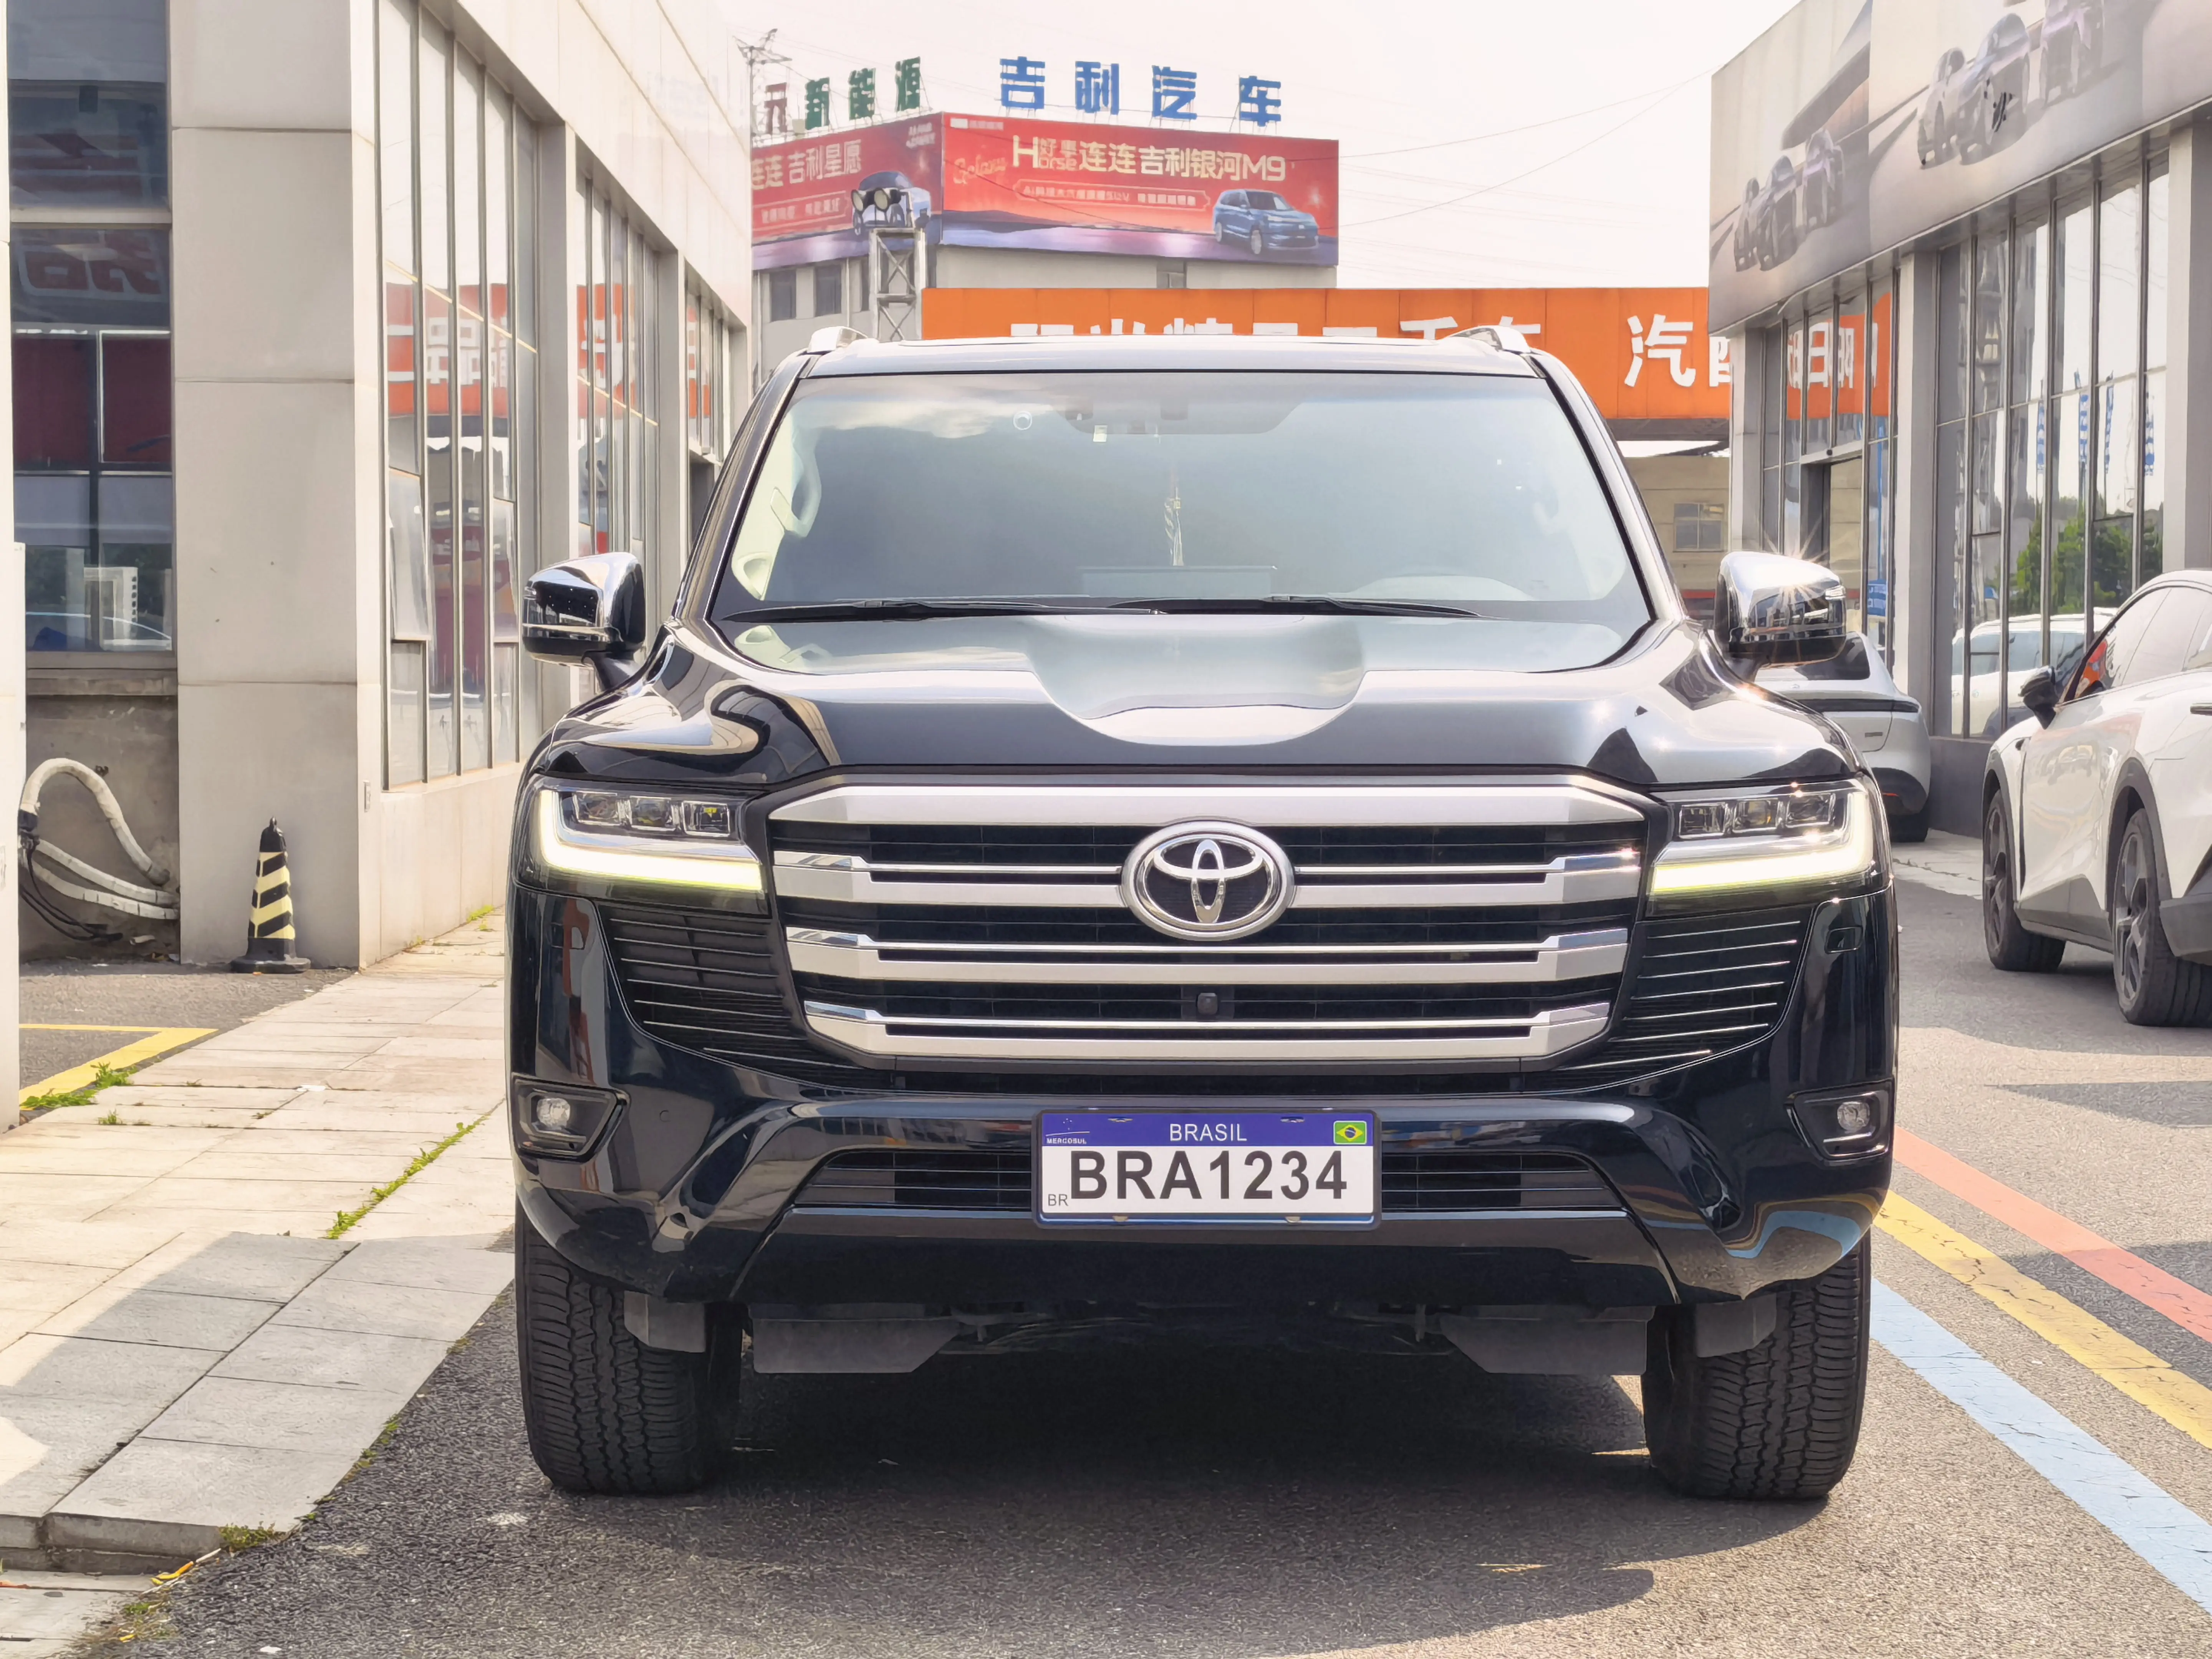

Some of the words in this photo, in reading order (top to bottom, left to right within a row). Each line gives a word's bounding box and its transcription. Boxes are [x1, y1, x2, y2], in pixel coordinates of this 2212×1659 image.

[1000, 56, 1281, 127] 吉利汽车
[1169, 1123, 1247, 1142] BRASIL
[1070, 1150, 1347, 1200] BRA1234
[1047, 1194, 1069, 1207] BR
